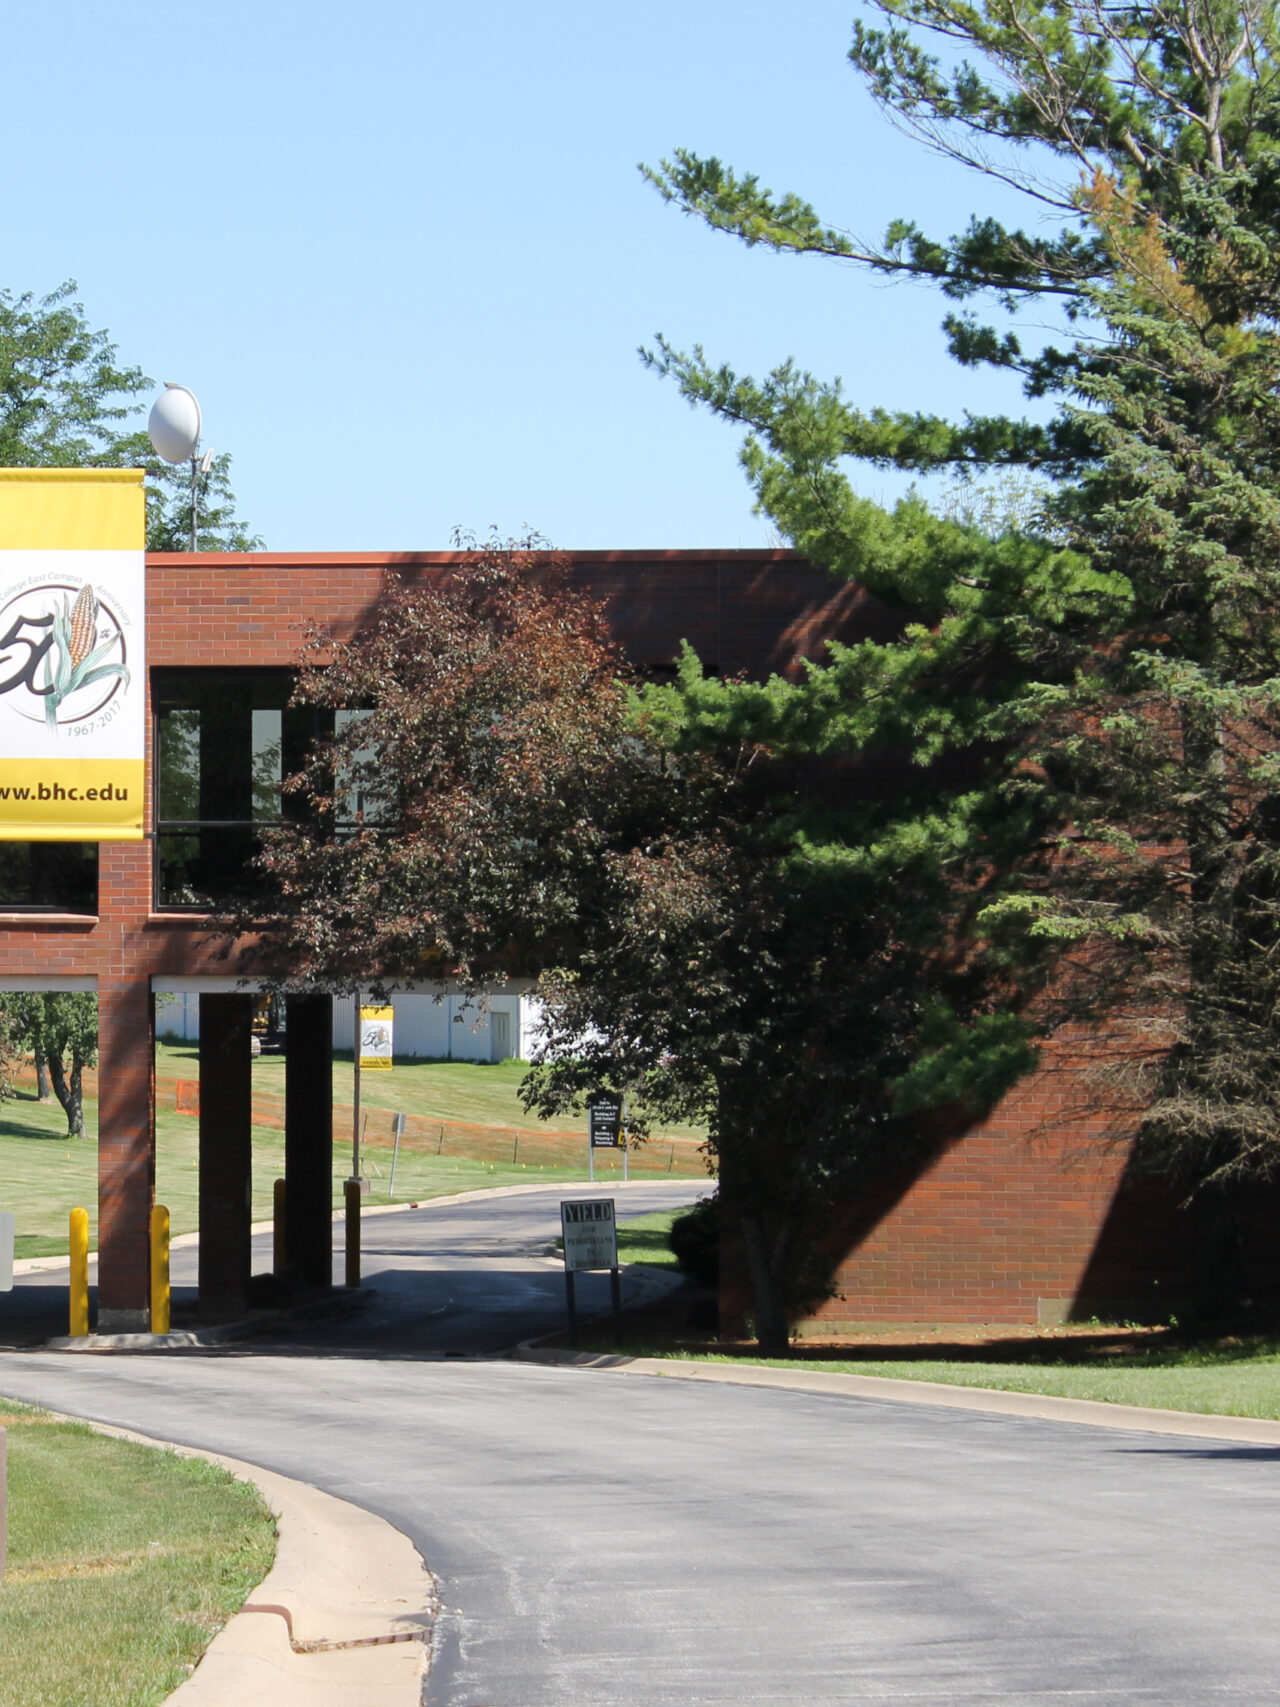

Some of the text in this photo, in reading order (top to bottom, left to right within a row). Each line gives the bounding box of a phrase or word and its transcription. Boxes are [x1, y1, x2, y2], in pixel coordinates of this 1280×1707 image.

[28, 573, 46, 585] East
[47, 571, 83, 584] Campus
[95, 584, 132, 627] Anniversary
[67, 700, 122, 737] 1967-2017
[566, 1203, 610, 1221] YIELD
